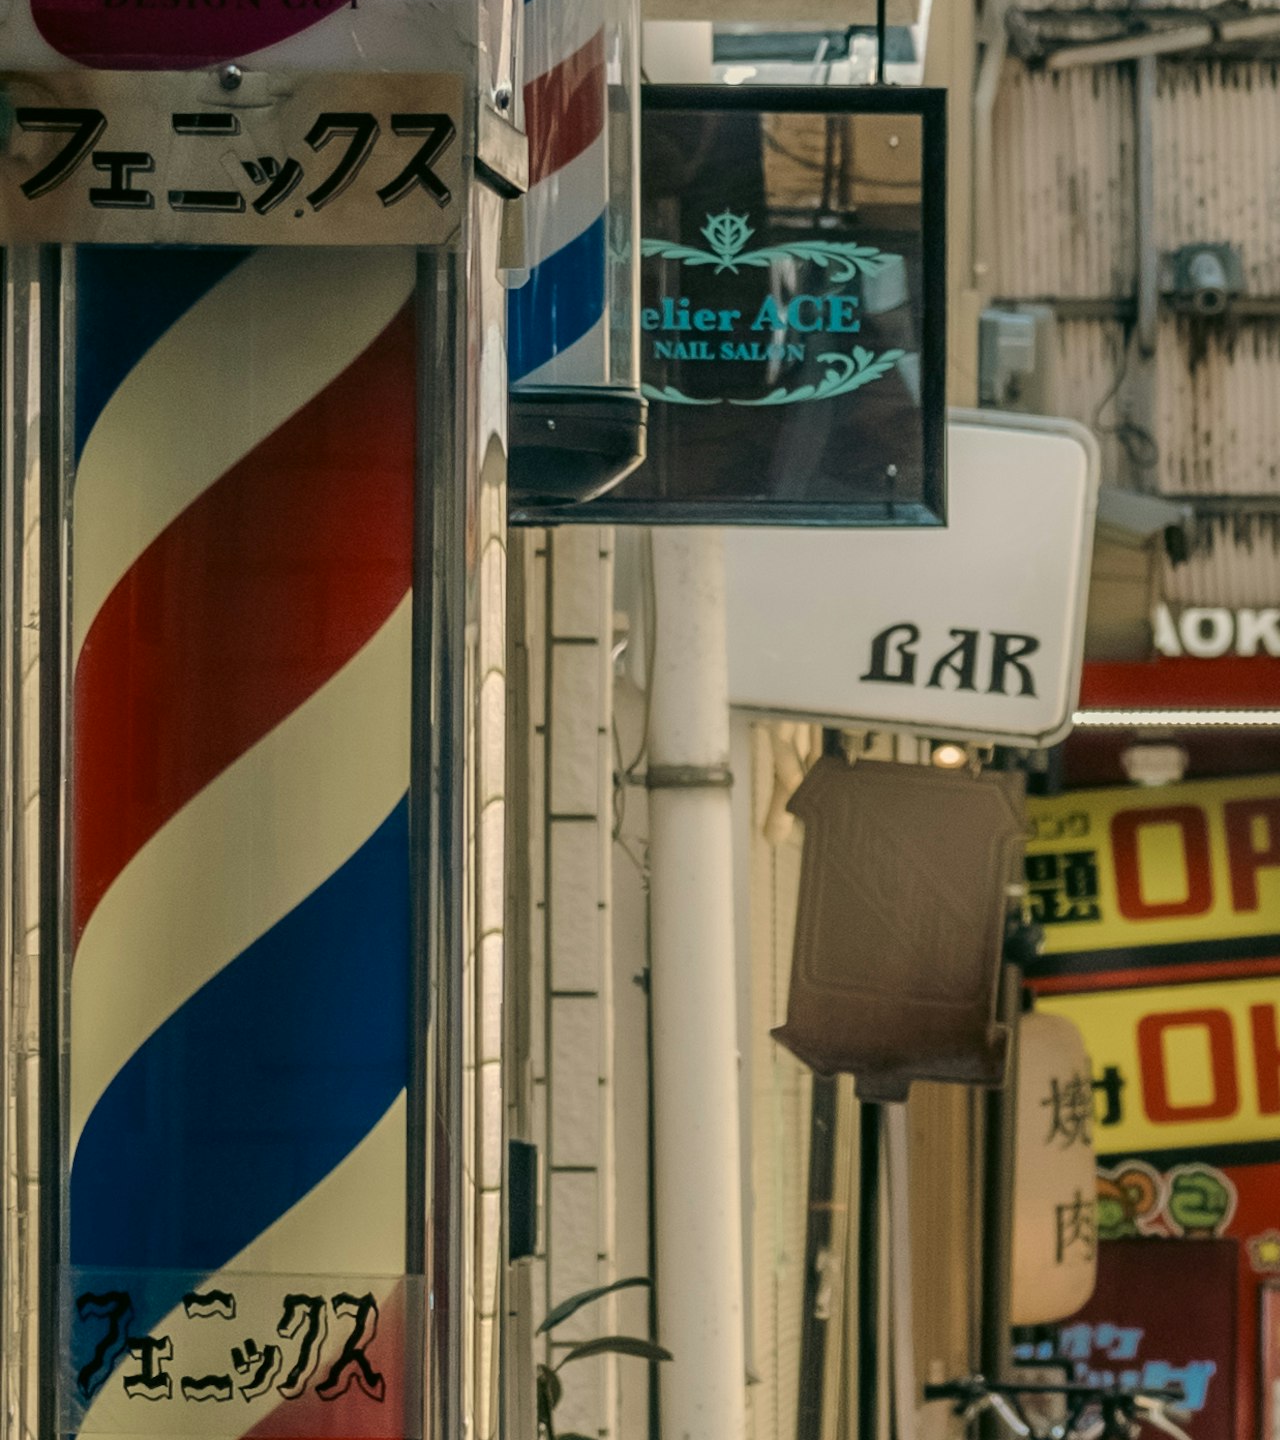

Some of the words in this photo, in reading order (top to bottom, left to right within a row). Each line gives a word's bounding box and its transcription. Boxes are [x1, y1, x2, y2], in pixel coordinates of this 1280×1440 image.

[15, 106, 458, 218] フェニックス
[653, 340, 716, 360] NAIL
[720, 340, 806, 361] SALON
[750, 292, 862, 334] ACE
[858, 623, 1041, 699] BAR
[77, 1289, 386, 1403] フェニックス
